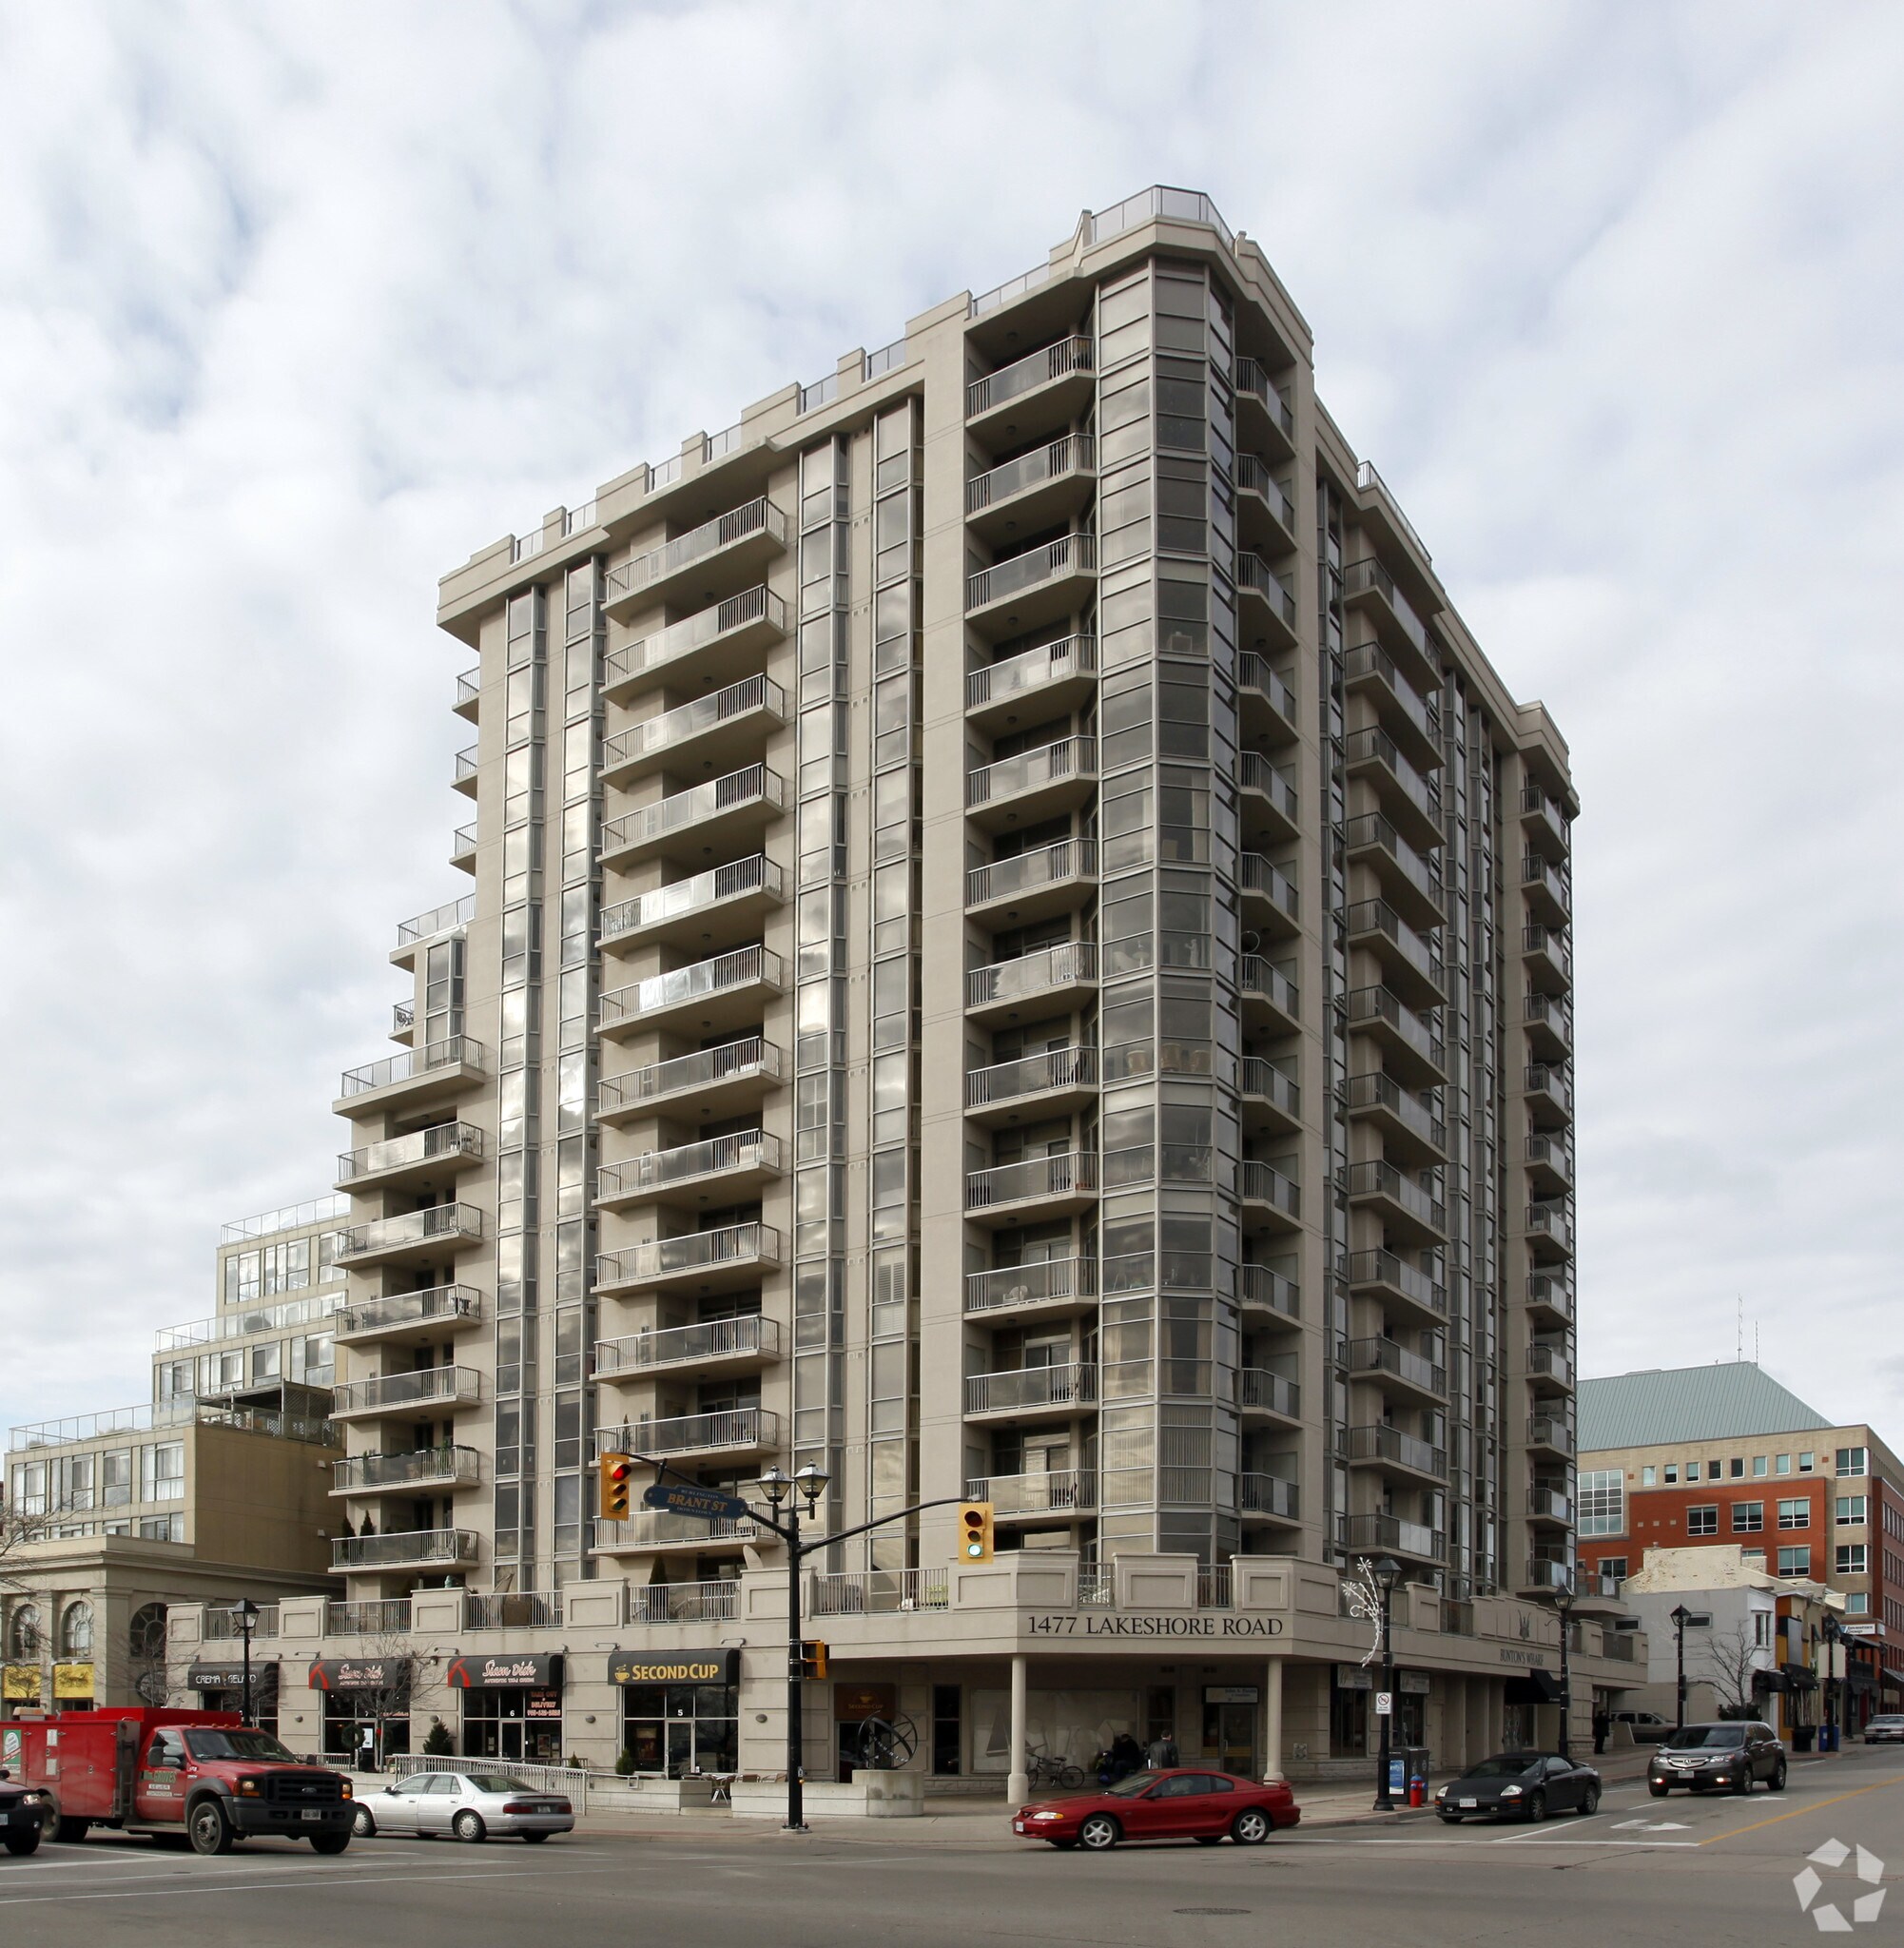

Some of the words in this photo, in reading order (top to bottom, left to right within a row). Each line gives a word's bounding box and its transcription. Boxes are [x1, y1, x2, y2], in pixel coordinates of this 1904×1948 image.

[667, 1493, 711, 1510] BRANT
[711, 1500, 729, 1512] ST
[1028, 1616, 1078, 1633] 1477
[1086, 1617, 1214, 1635] LAKESHORE
[1222, 1618, 1283, 1635] ROAD
[482, 1659, 512, 1677] Siam
[512, 1660, 537, 1677] Dish
[195, 1675, 221, 1685] CREMA
[677, 1708, 684, 1717] 5
[153, 1770, 177, 1783] GROVES
